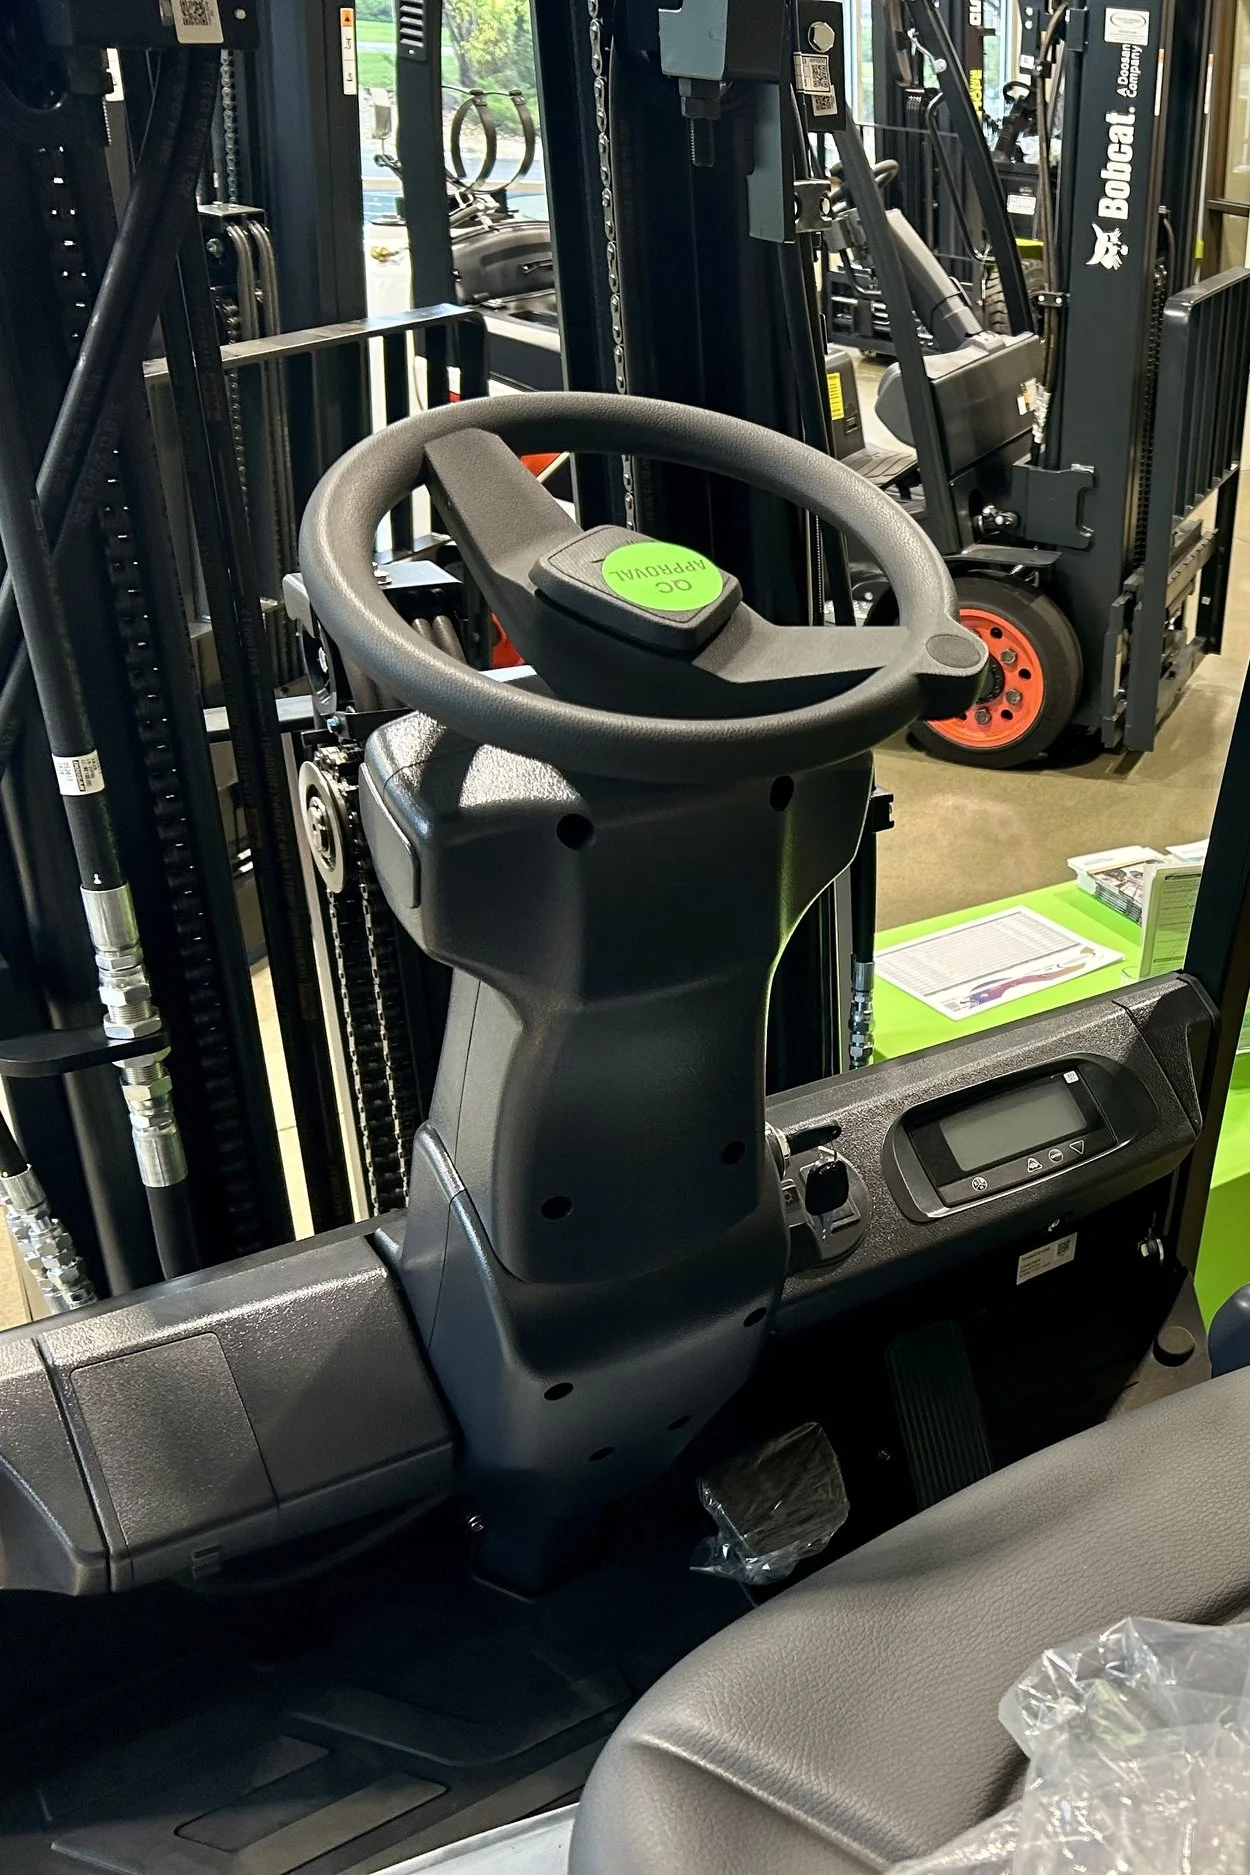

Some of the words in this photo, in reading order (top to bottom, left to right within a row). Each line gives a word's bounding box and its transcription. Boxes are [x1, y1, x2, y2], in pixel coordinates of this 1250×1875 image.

[1117, 43, 1131, 86] Doosan
[1126, 45, 1142, 98] Company
[1117, 87, 1128, 98] A
[608, 559, 707, 582] APPROVAL
[654, 579, 693, 594] QC
